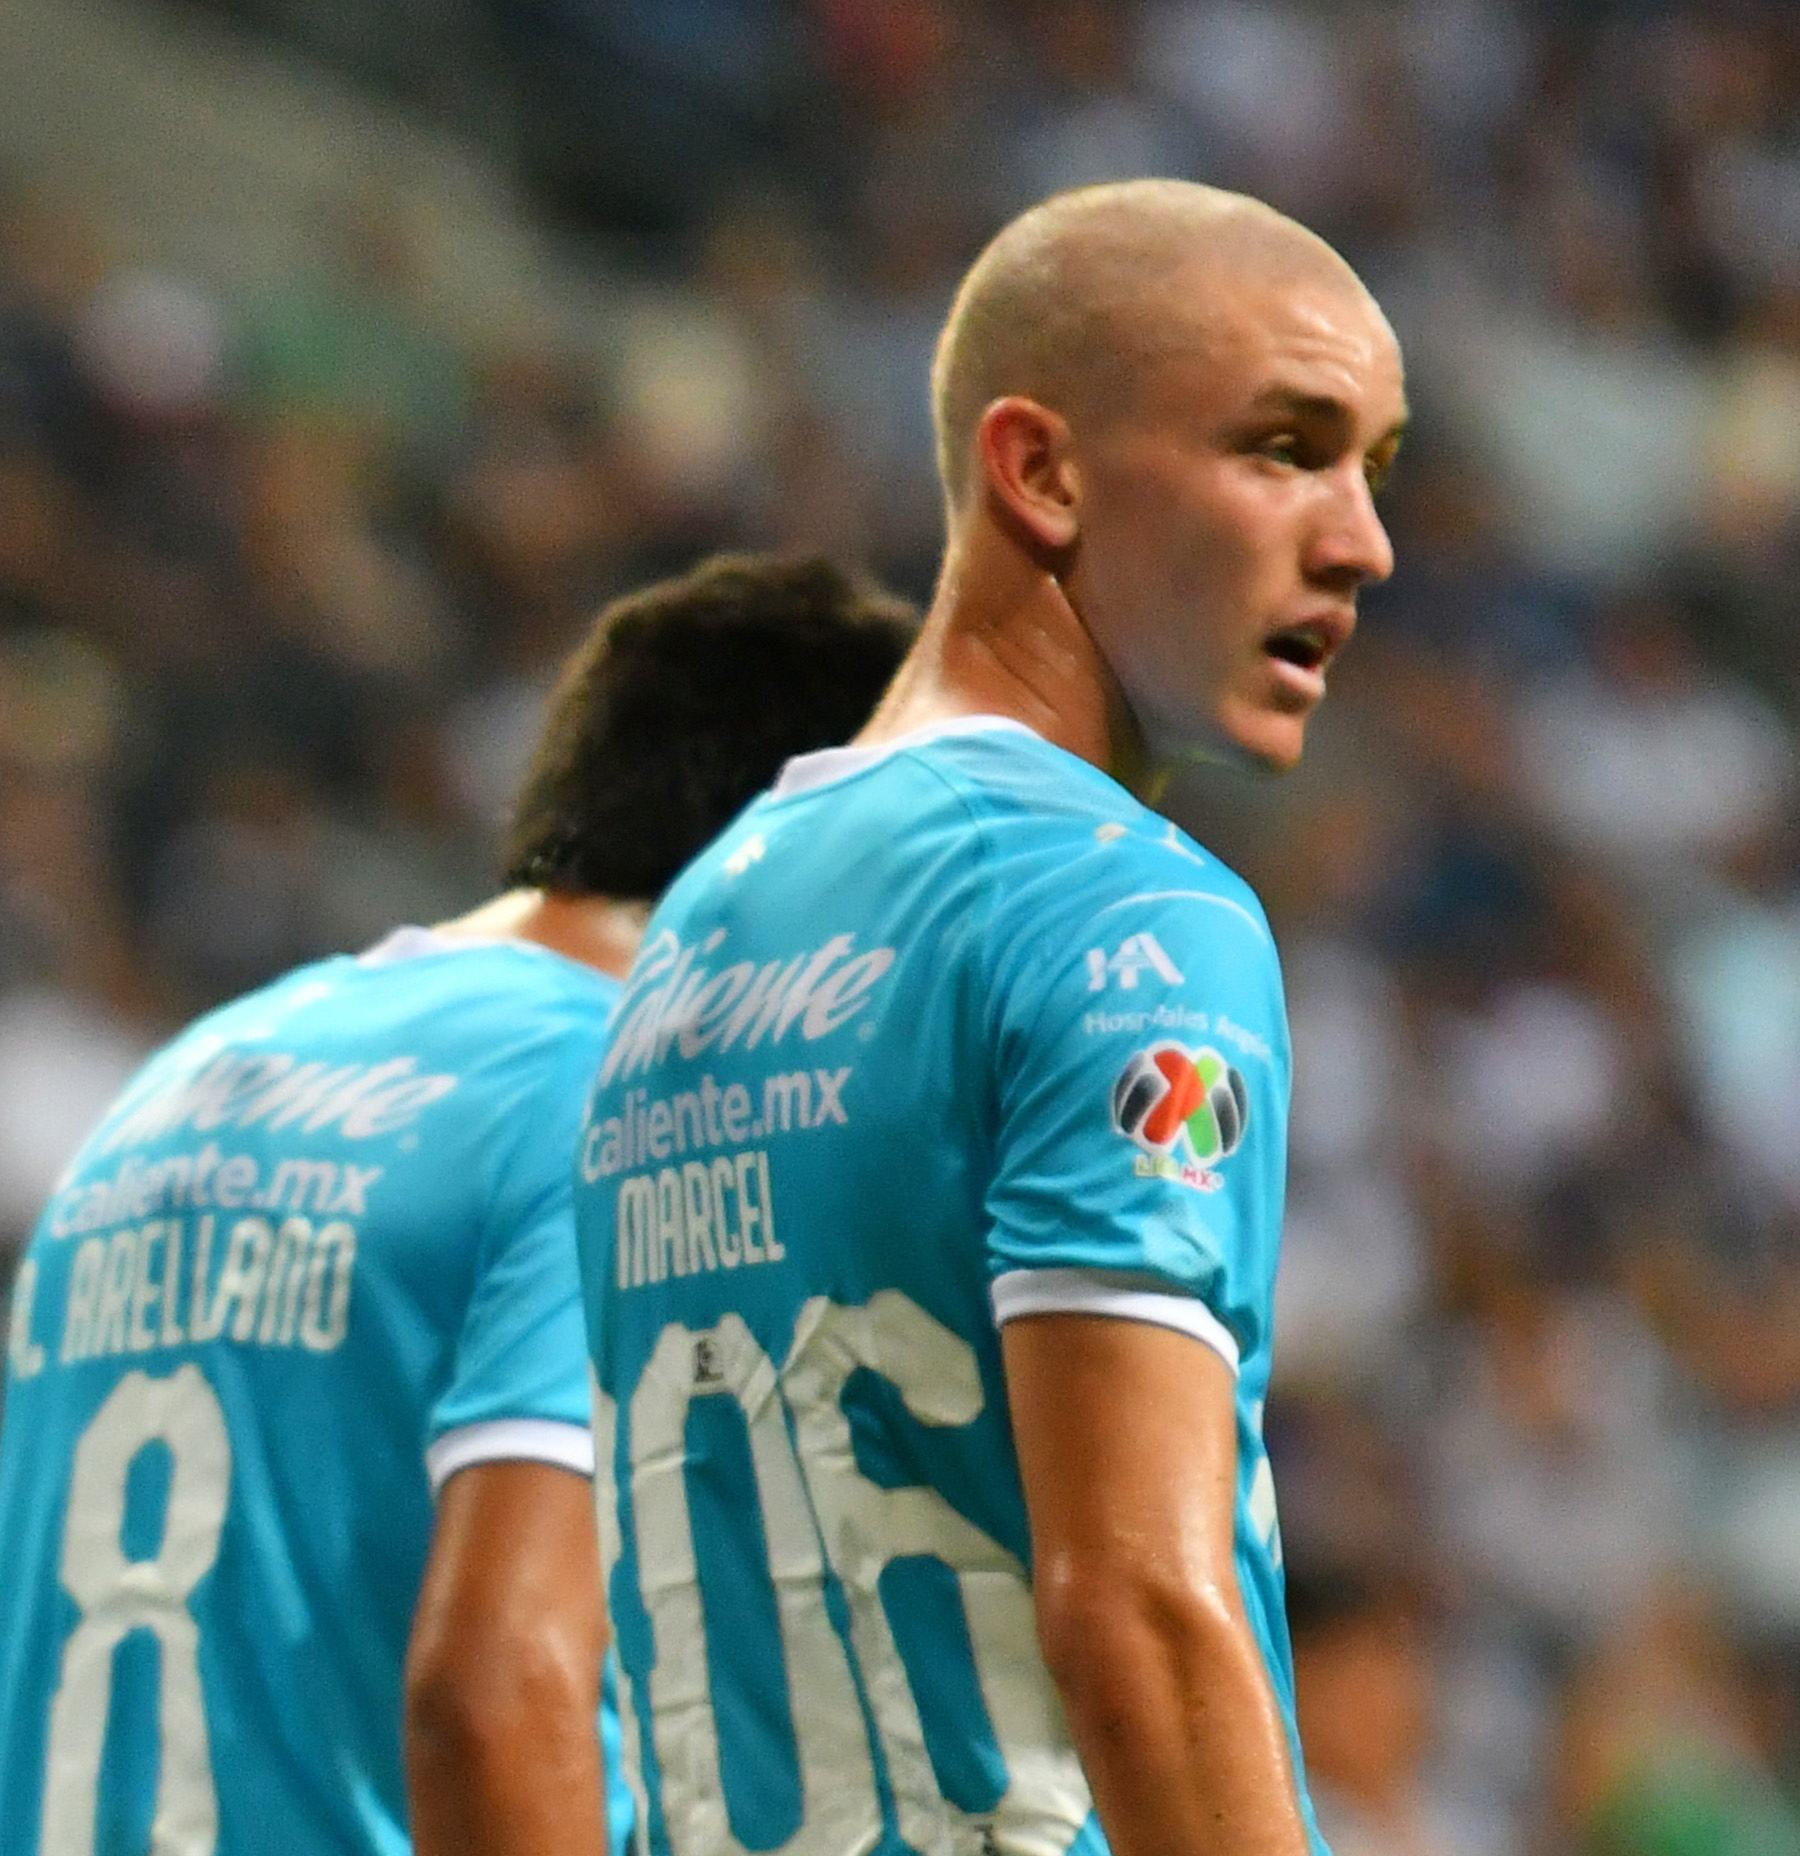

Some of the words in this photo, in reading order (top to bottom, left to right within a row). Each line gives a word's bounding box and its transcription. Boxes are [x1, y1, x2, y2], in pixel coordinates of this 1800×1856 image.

[581, 1066, 853, 1184] caliente.mx
[59, 1214, 357, 1365] ARELLANO
[617, 1150, 786, 1291] MARCEL
